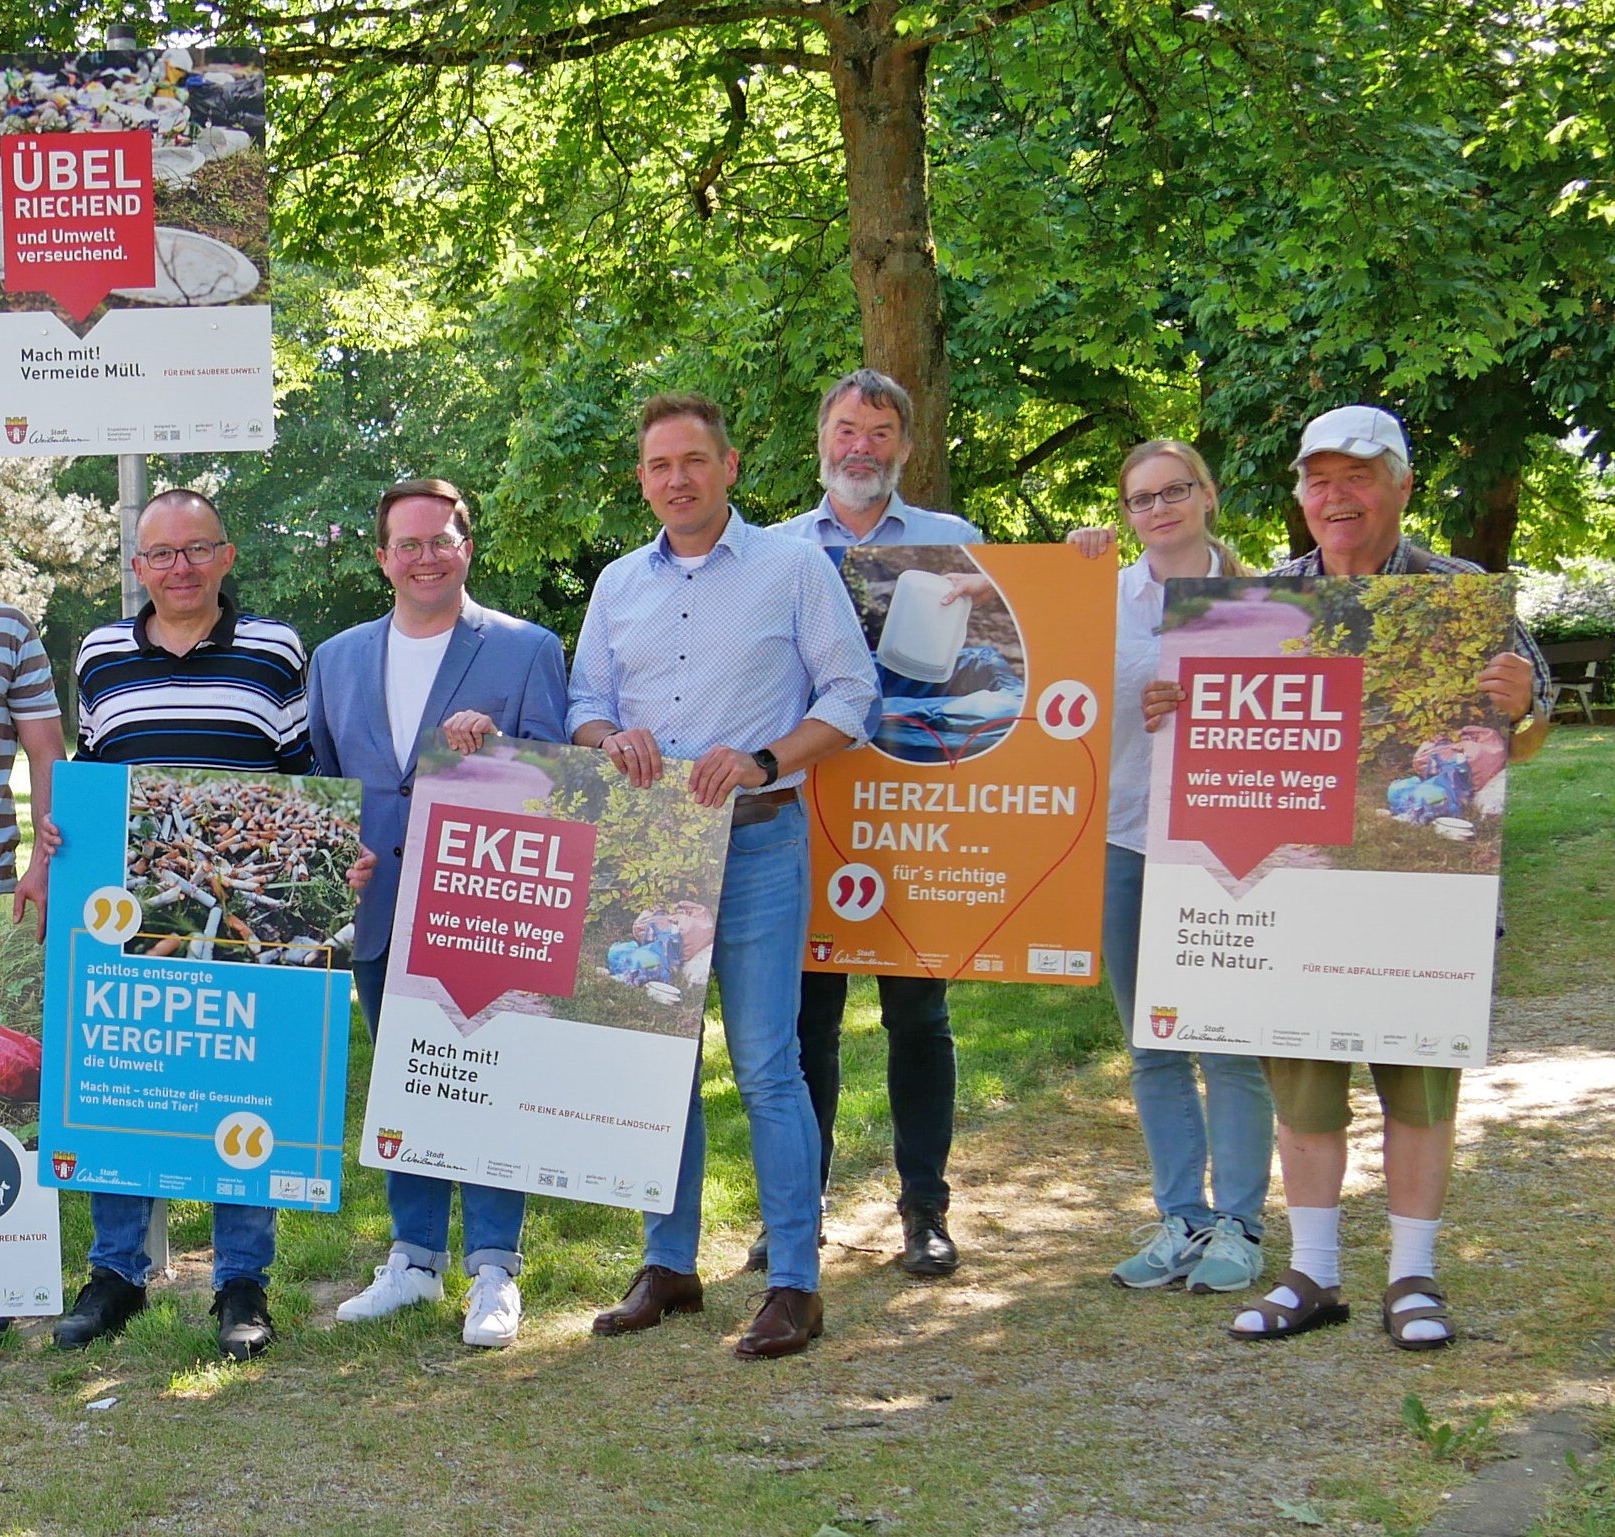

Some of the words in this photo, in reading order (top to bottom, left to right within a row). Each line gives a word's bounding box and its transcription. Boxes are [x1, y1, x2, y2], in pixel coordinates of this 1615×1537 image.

[14, 142, 140, 191] ÜBEL
[16, 195, 140, 218] RIECHEND
[18, 230, 46, 244] und
[53, 228, 114, 243] Umwelt
[18, 246, 127, 262] verseuchend.
[22, 348, 62, 362] Mach
[69, 347, 99, 360] mit!
[21, 365, 98, 380] Vermeide
[106, 364, 144, 377] Müll.
[164, 368, 177, 377] FÜR
[197, 368, 229, 376] SAUBERE
[231, 367, 261, 375] UMWELT
[1192, 674, 1342, 720] EKEL
[1190, 728, 1340, 750] ERREGEND
[1188, 769, 1221, 785] wie
[1228, 770, 1274, 786] viele
[1281, 771, 1336, 792] Wege
[855, 782, 1075, 814] HERZLICHEN
[1186, 791, 1272, 808] vermüllt
[1278, 793, 1325, 809] sind.
[853, 822, 949, 852] DANK
[436, 821, 574, 881] EKEL
[939, 867, 1006, 886] richtige
[433, 870, 572, 909] ERREGEND
[909, 885, 1004, 905] Entsorgen!
[1180, 908, 1228, 924] Mach
[1237, 912, 1275, 926] mit!
[430, 912, 460, 928] wie
[466, 916, 508, 934] viele
[514, 922, 563, 945] Wege
[1178, 929, 1254, 947] Schütze
[427, 933, 504, 955] vermüllt
[509, 943, 552, 962] sind.
[857, 949, 875, 957] Stadt
[1177, 951, 1204, 966] die
[1212, 952, 1272, 970] Natur.
[88, 963, 138, 977] achtlos
[144, 968, 212, 984] entsorgte
[1302, 964, 1320, 973] FÜR
[1324, 965, 1344, 974] EINE
[1348, 967, 1410, 977] ABFALLFREIE
[1412, 970, 1475, 980] LANDSCHAFT
[86, 980, 255, 1028] KIPPEN
[1204, 1025, 1224, 1033] Stadt
[82, 1024, 254, 1061] VERGIFTEN
[412, 1039, 456, 1059] Mach
[463, 1047, 499, 1066] mit!
[84, 1054, 104, 1067] die
[110, 1056, 163, 1072] Umwelt
[408, 1059, 477, 1082] Schütze
[81, 1081, 109, 1092] Mach
[112, 1084, 130, 1094] mit
[143, 1087, 185, 1098] schütze
[189, 1089, 205, 1100] die
[210, 1092, 272, 1106] Gesundheit
[406, 1079, 430, 1095] die
[438, 1083, 492, 1105] Natur.
[79, 1096, 99, 1104] von
[103, 1095, 144, 1107] Mensch
[147, 1098, 168, 1110] und
[172, 1101, 198, 1112] Tier!
[519, 1102, 535, 1111] FÜR
[537, 1105, 557, 1114] EINE
[559, 1110, 614, 1124] ABFALLFREIE
[616, 1119, 670, 1132] LANDSCHAFT
[425, 1149, 444, 1160] Stadt
[20, 1233, 47, 1241] NATUR
